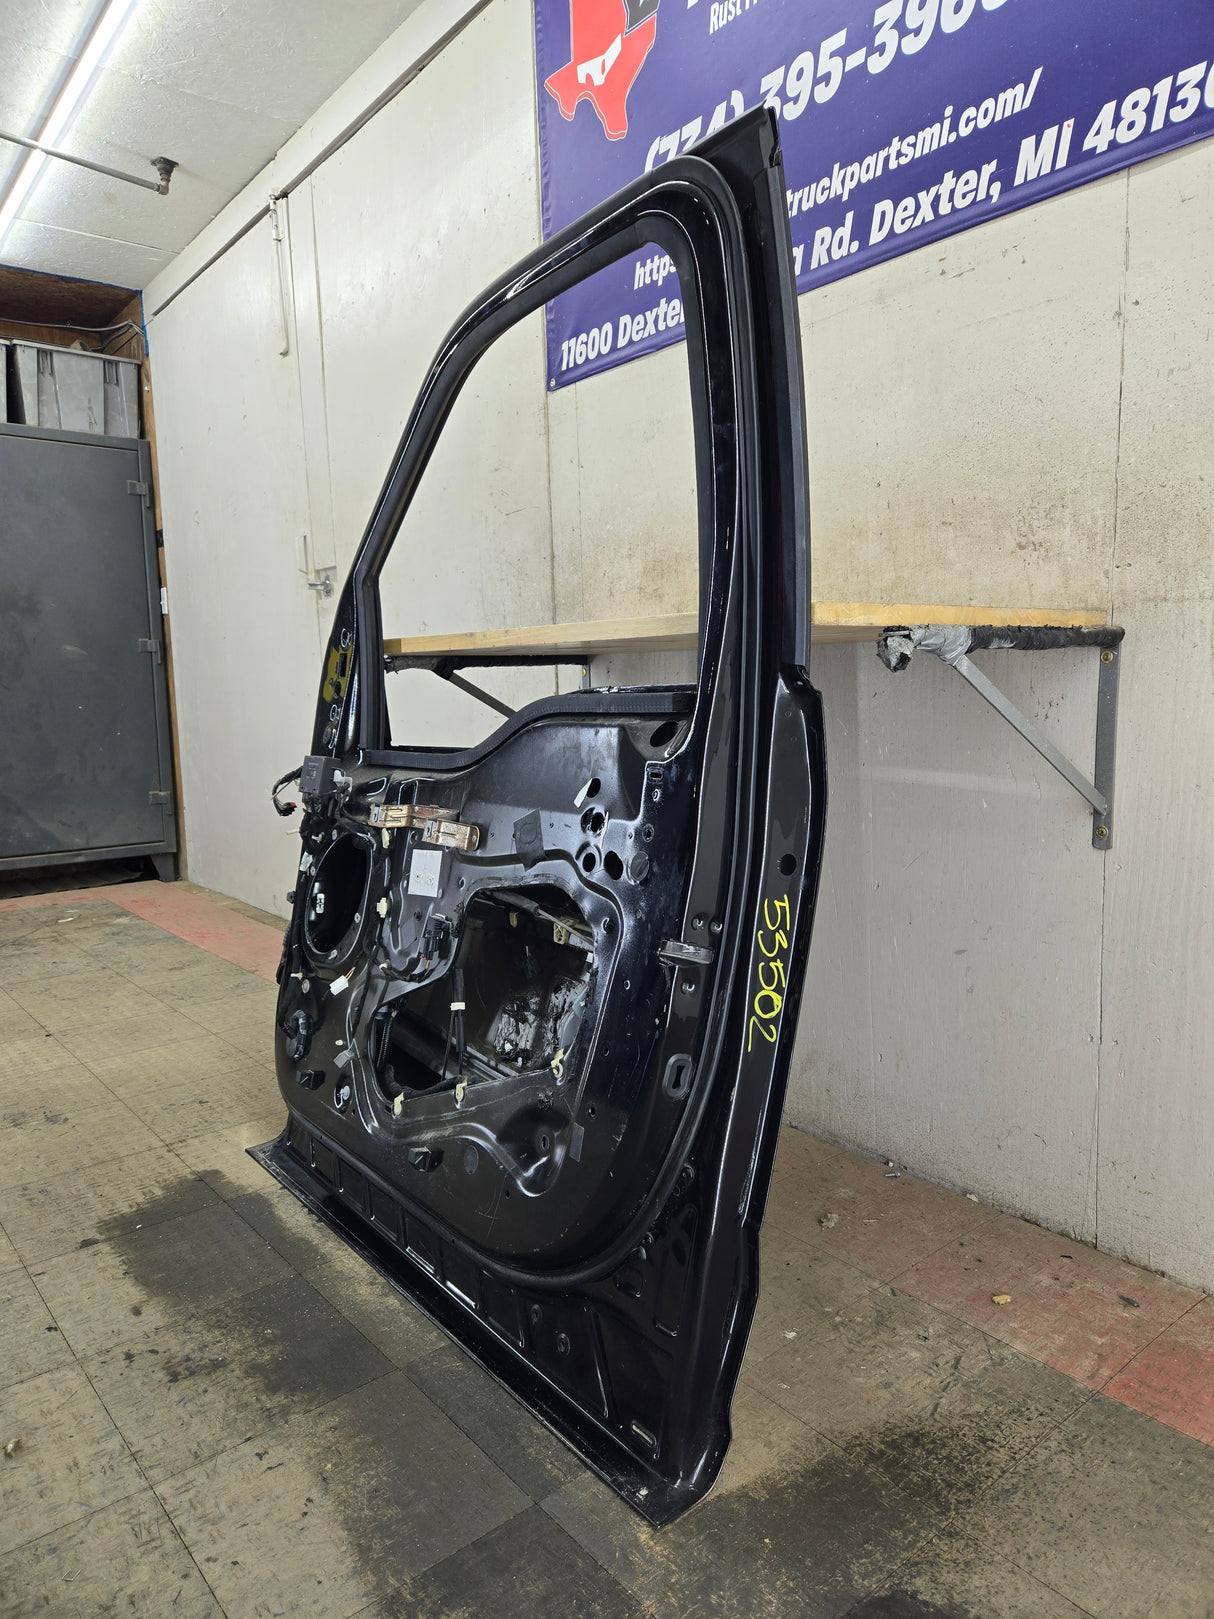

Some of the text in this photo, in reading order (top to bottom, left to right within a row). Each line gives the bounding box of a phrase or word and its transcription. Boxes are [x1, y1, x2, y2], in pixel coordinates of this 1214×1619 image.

[759, 0, 1008, 123] 395-39
[561, 322, 613, 371] 11600
[617, 298, 685, 349] Dexte
[810, 211, 859, 270] Rd.
[868, 159, 1001, 246] Dexter,
[1013, 117, 1075, 187] MI
[747, 894, 790, 1052] 53502
